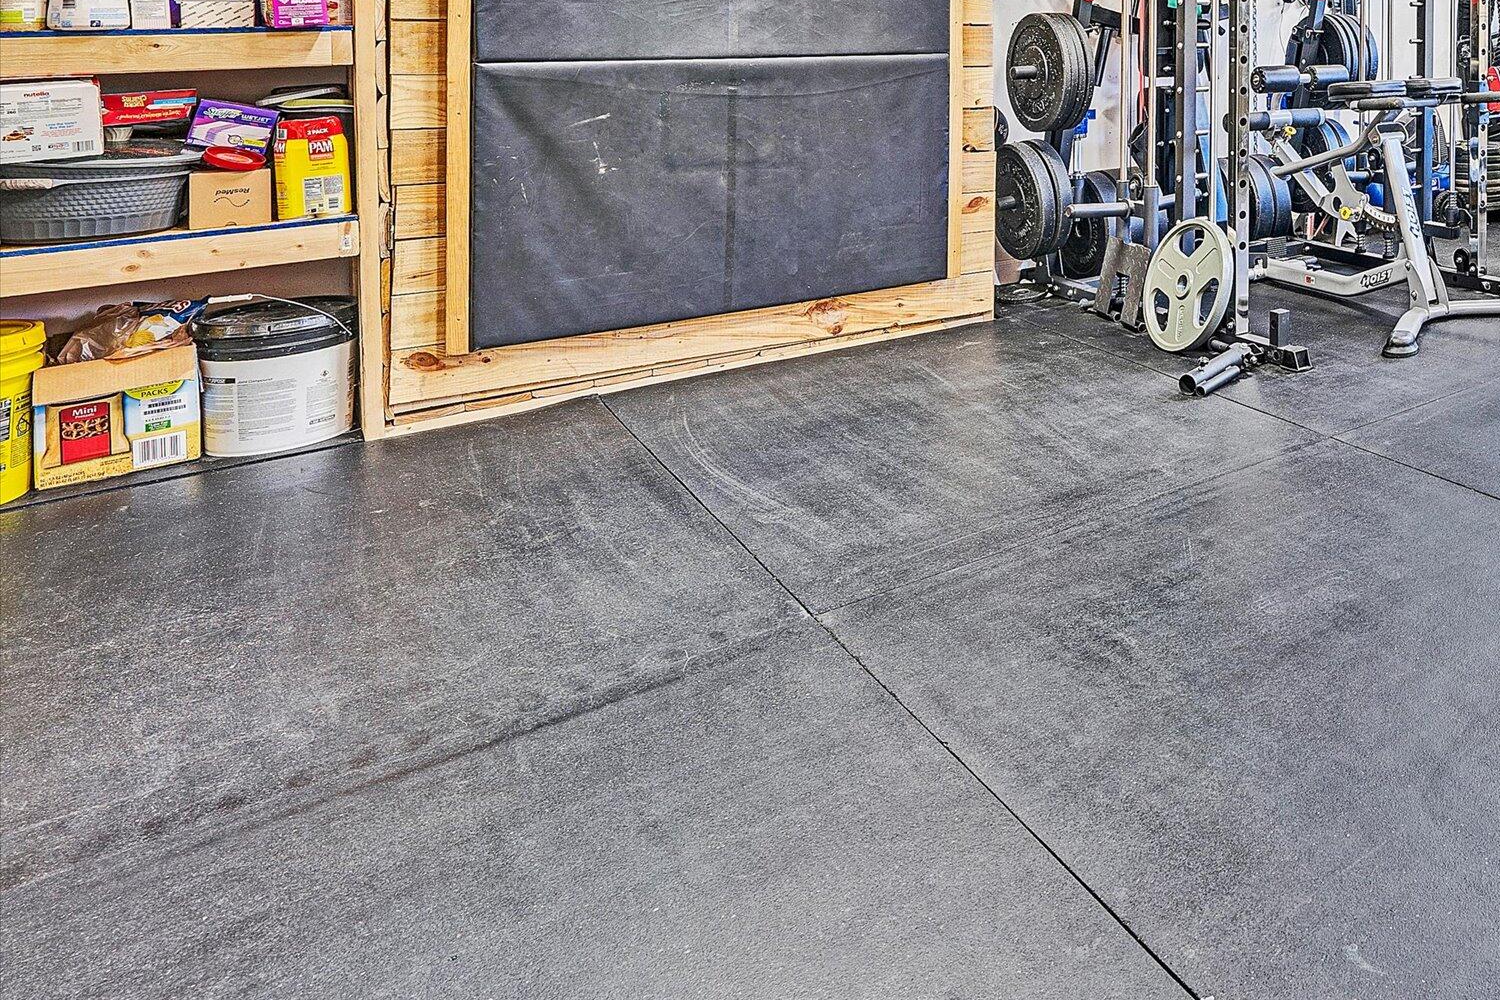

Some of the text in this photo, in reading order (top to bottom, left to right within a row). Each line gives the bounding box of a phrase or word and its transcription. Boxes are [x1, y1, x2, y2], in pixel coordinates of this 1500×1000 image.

[202, 107, 272, 124] Swiffer WETJET
[308, 140, 334, 154] PAM
[214, 188, 251, 197] ResMed
[1401, 187, 1421, 238] HOIST
[1360, 268, 1394, 289] HOIST
[140, 387, 169, 398] PACKS
[72, 406, 97, 417] Mini
